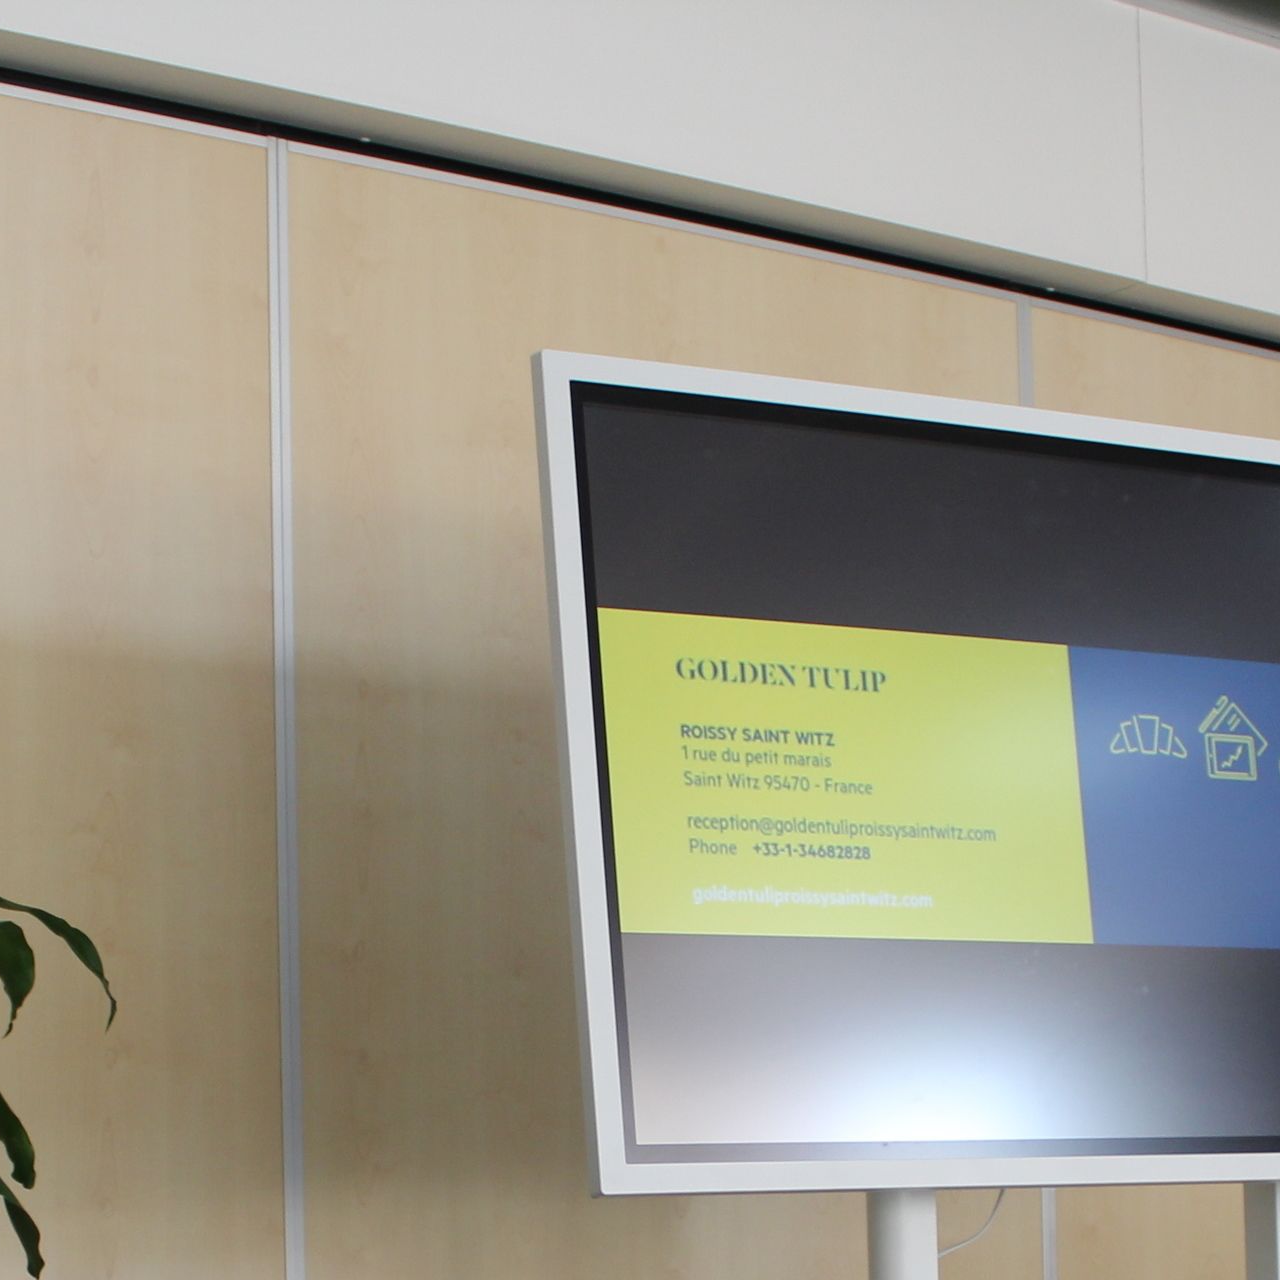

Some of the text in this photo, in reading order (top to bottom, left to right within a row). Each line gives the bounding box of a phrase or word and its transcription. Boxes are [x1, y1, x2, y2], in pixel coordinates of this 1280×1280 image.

[675, 657, 886, 693] GOLDEN TULIP
[680, 724, 835, 747] ROISSY SAINT WITZ
[681, 745, 832, 768] 1 rue du petit marais
[683, 770, 722, 787] Saint
[726, 773, 761, 790] Witz
[764, 774, 810, 793] 95470
[824, 777, 873, 795] France
[687, 815, 997, 842] reception@goldentuliproissysaintwitz.com
[689, 838, 871, 860] Phone +33-1-34682828
[693, 884, 934, 908] goldentuliproissysaintwitz.com
